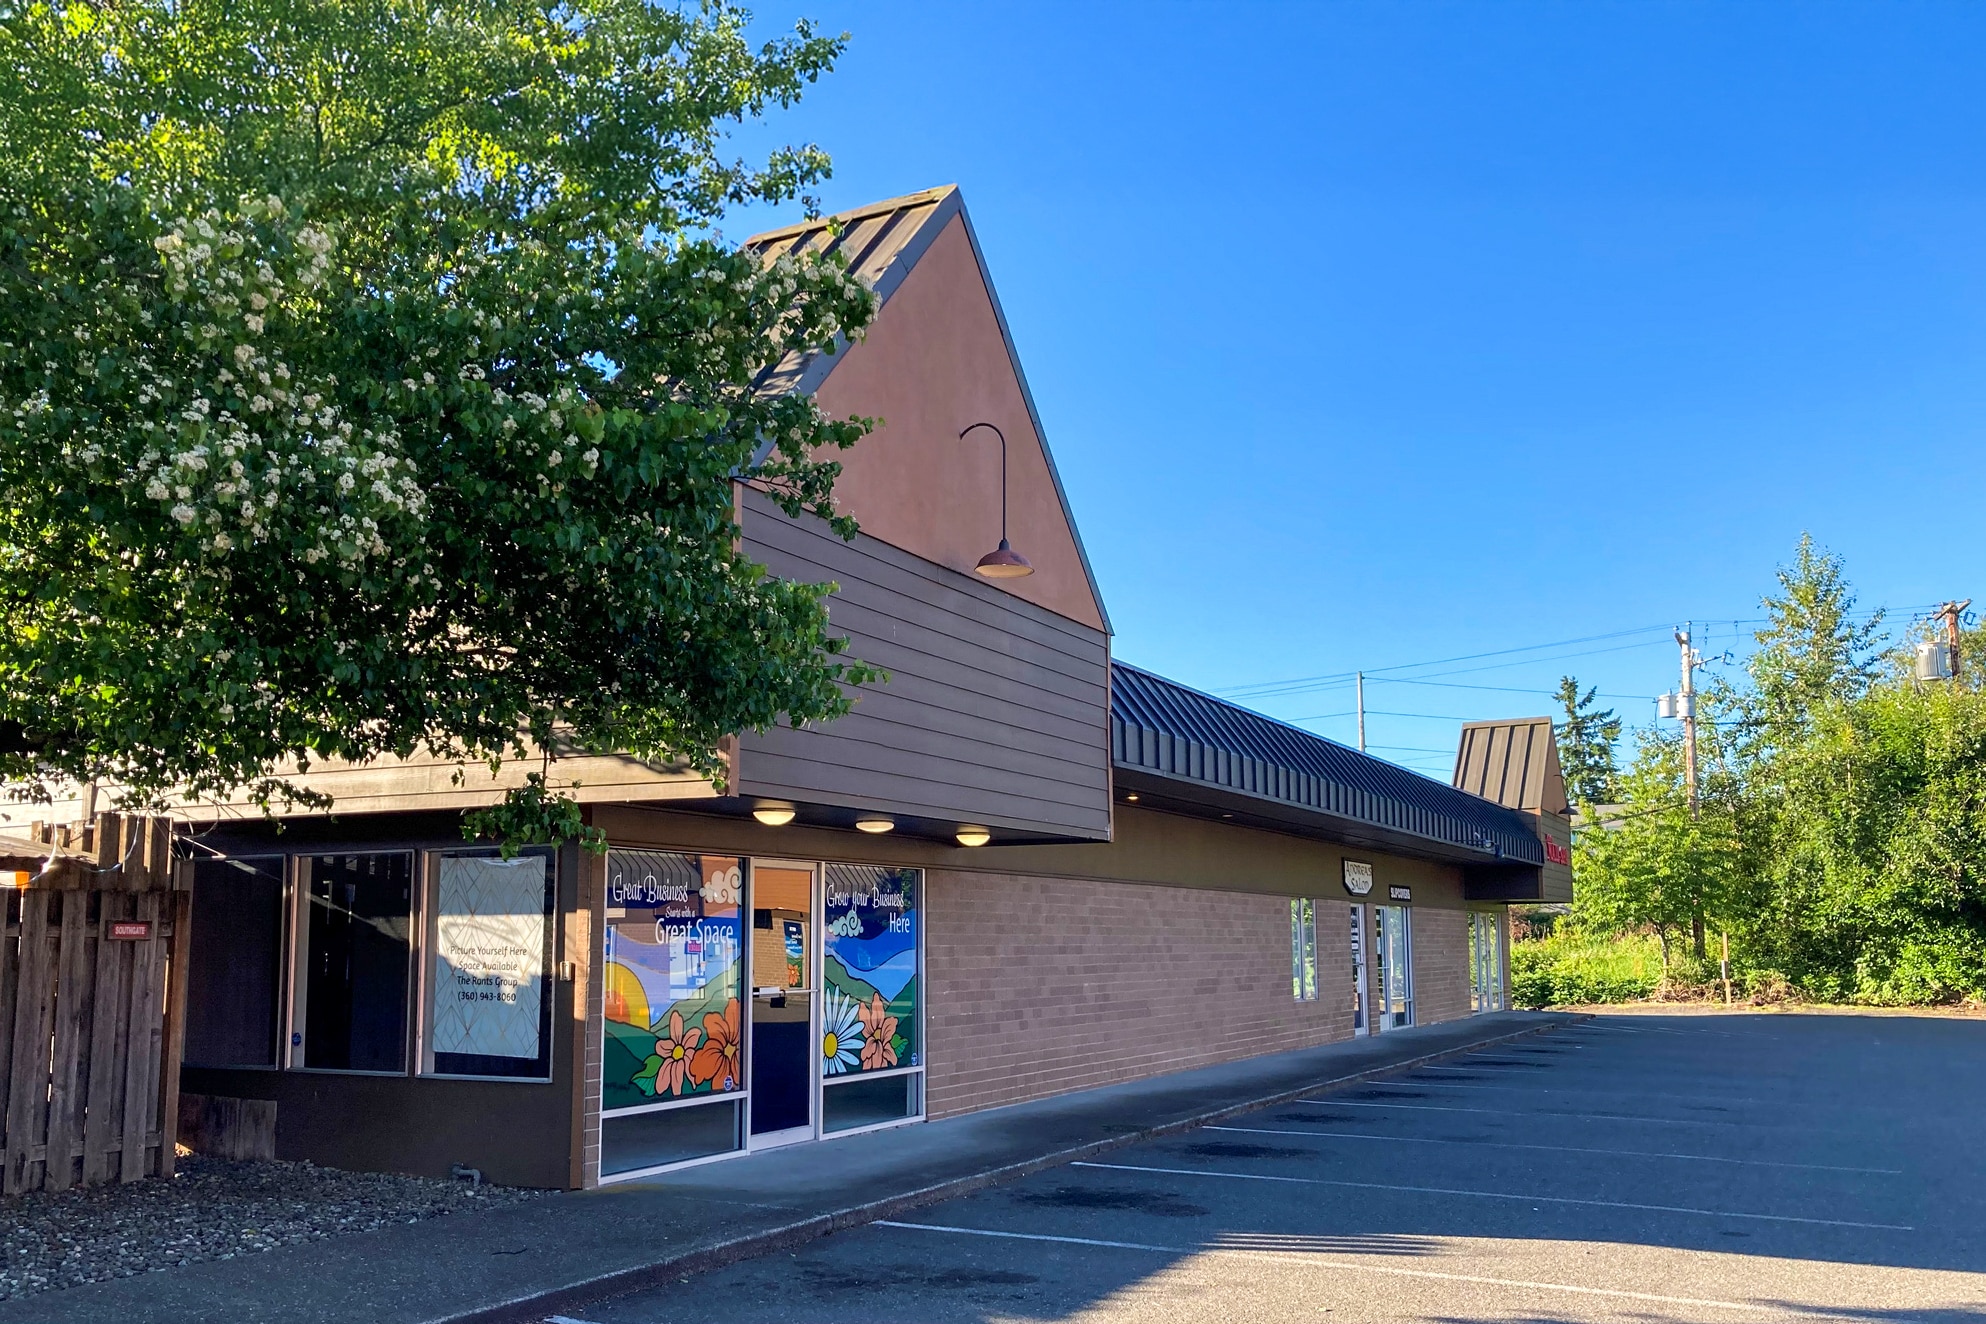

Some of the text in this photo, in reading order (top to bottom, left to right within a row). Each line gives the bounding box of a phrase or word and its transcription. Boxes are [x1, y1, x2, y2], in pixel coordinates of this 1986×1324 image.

[613, 871, 688, 903] Great Business
[826, 884, 904, 913] Grow your Business
[889, 912, 910, 934] Here
[115, 926, 146, 934] SOUTHGATE
[655, 918, 734, 951] Great Space
[450, 946, 528, 958] Picture Yourself Here
[459, 961, 518, 971] Space Available
[457, 976, 471, 986] The
[494, 977, 518, 988] Group
[458, 992, 517, 1002] (360) 943-8060
